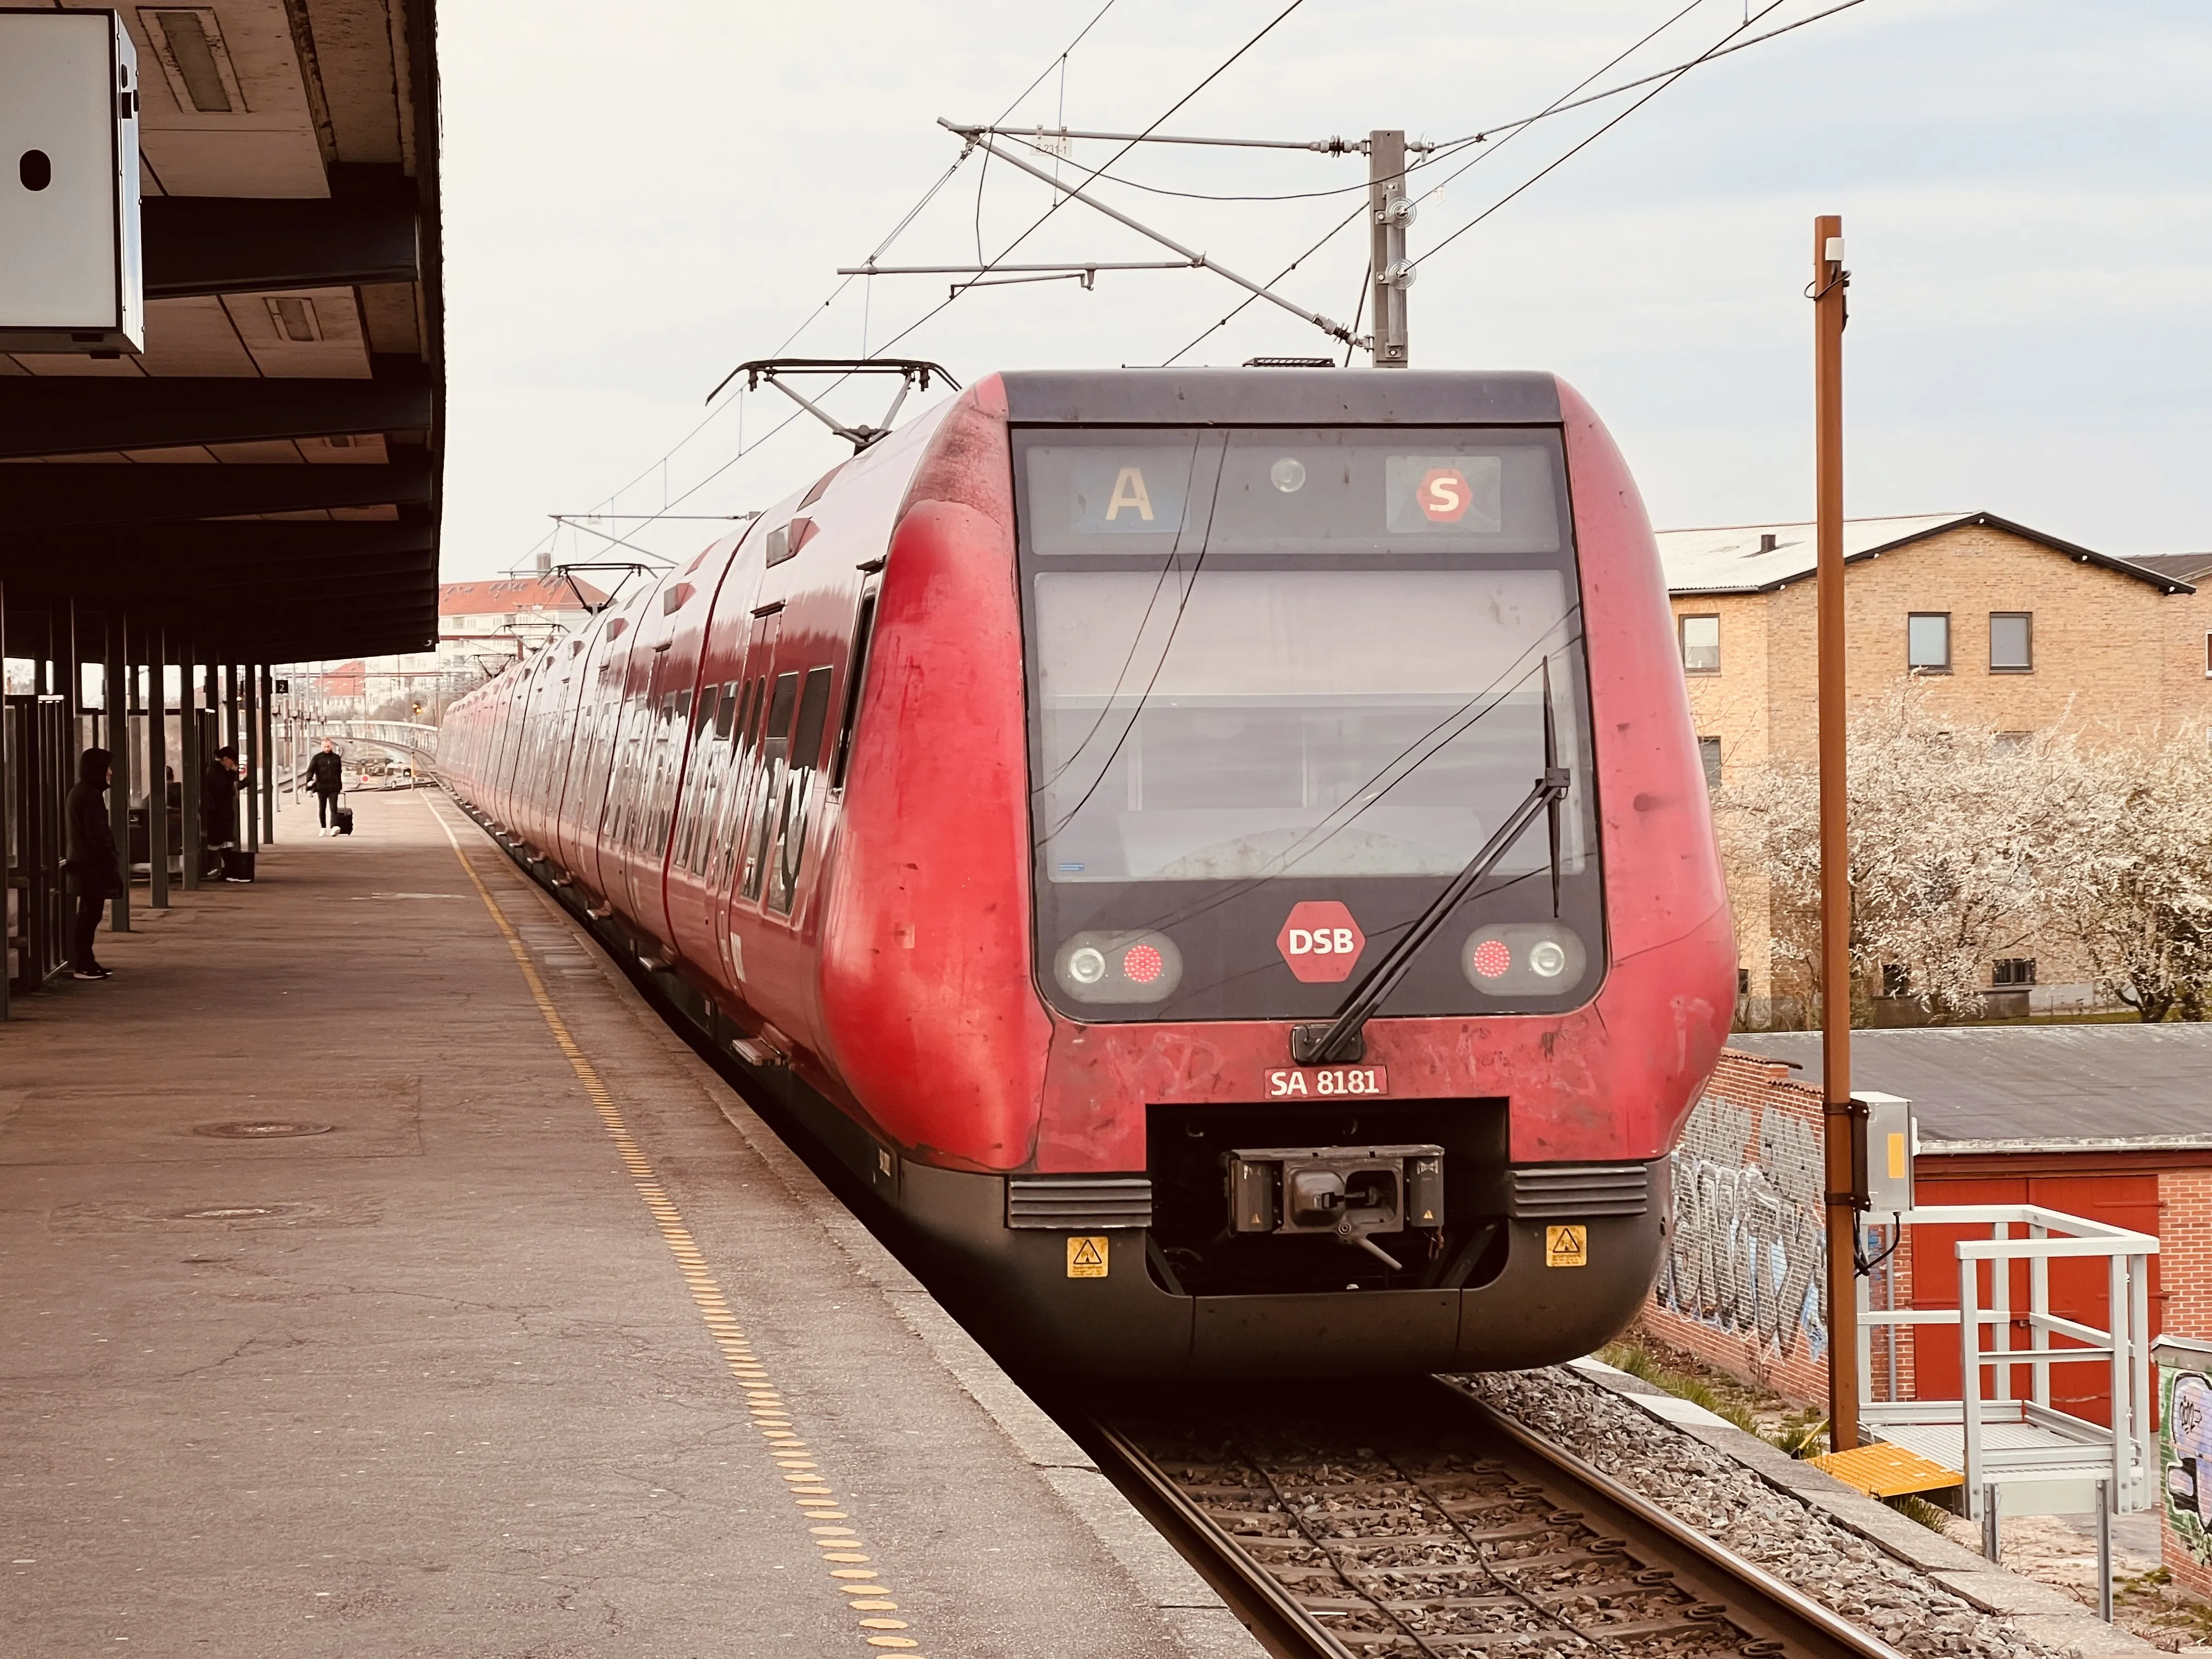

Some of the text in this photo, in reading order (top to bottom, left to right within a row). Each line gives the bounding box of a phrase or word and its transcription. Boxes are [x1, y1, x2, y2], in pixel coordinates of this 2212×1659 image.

[1105, 467, 1154, 520] A
[1429, 477, 1459, 512] S
[279, 684, 285, 692] 2
[1289, 928, 1354, 955] DSB
[1271, 1070, 1380, 1096] SA 8181
